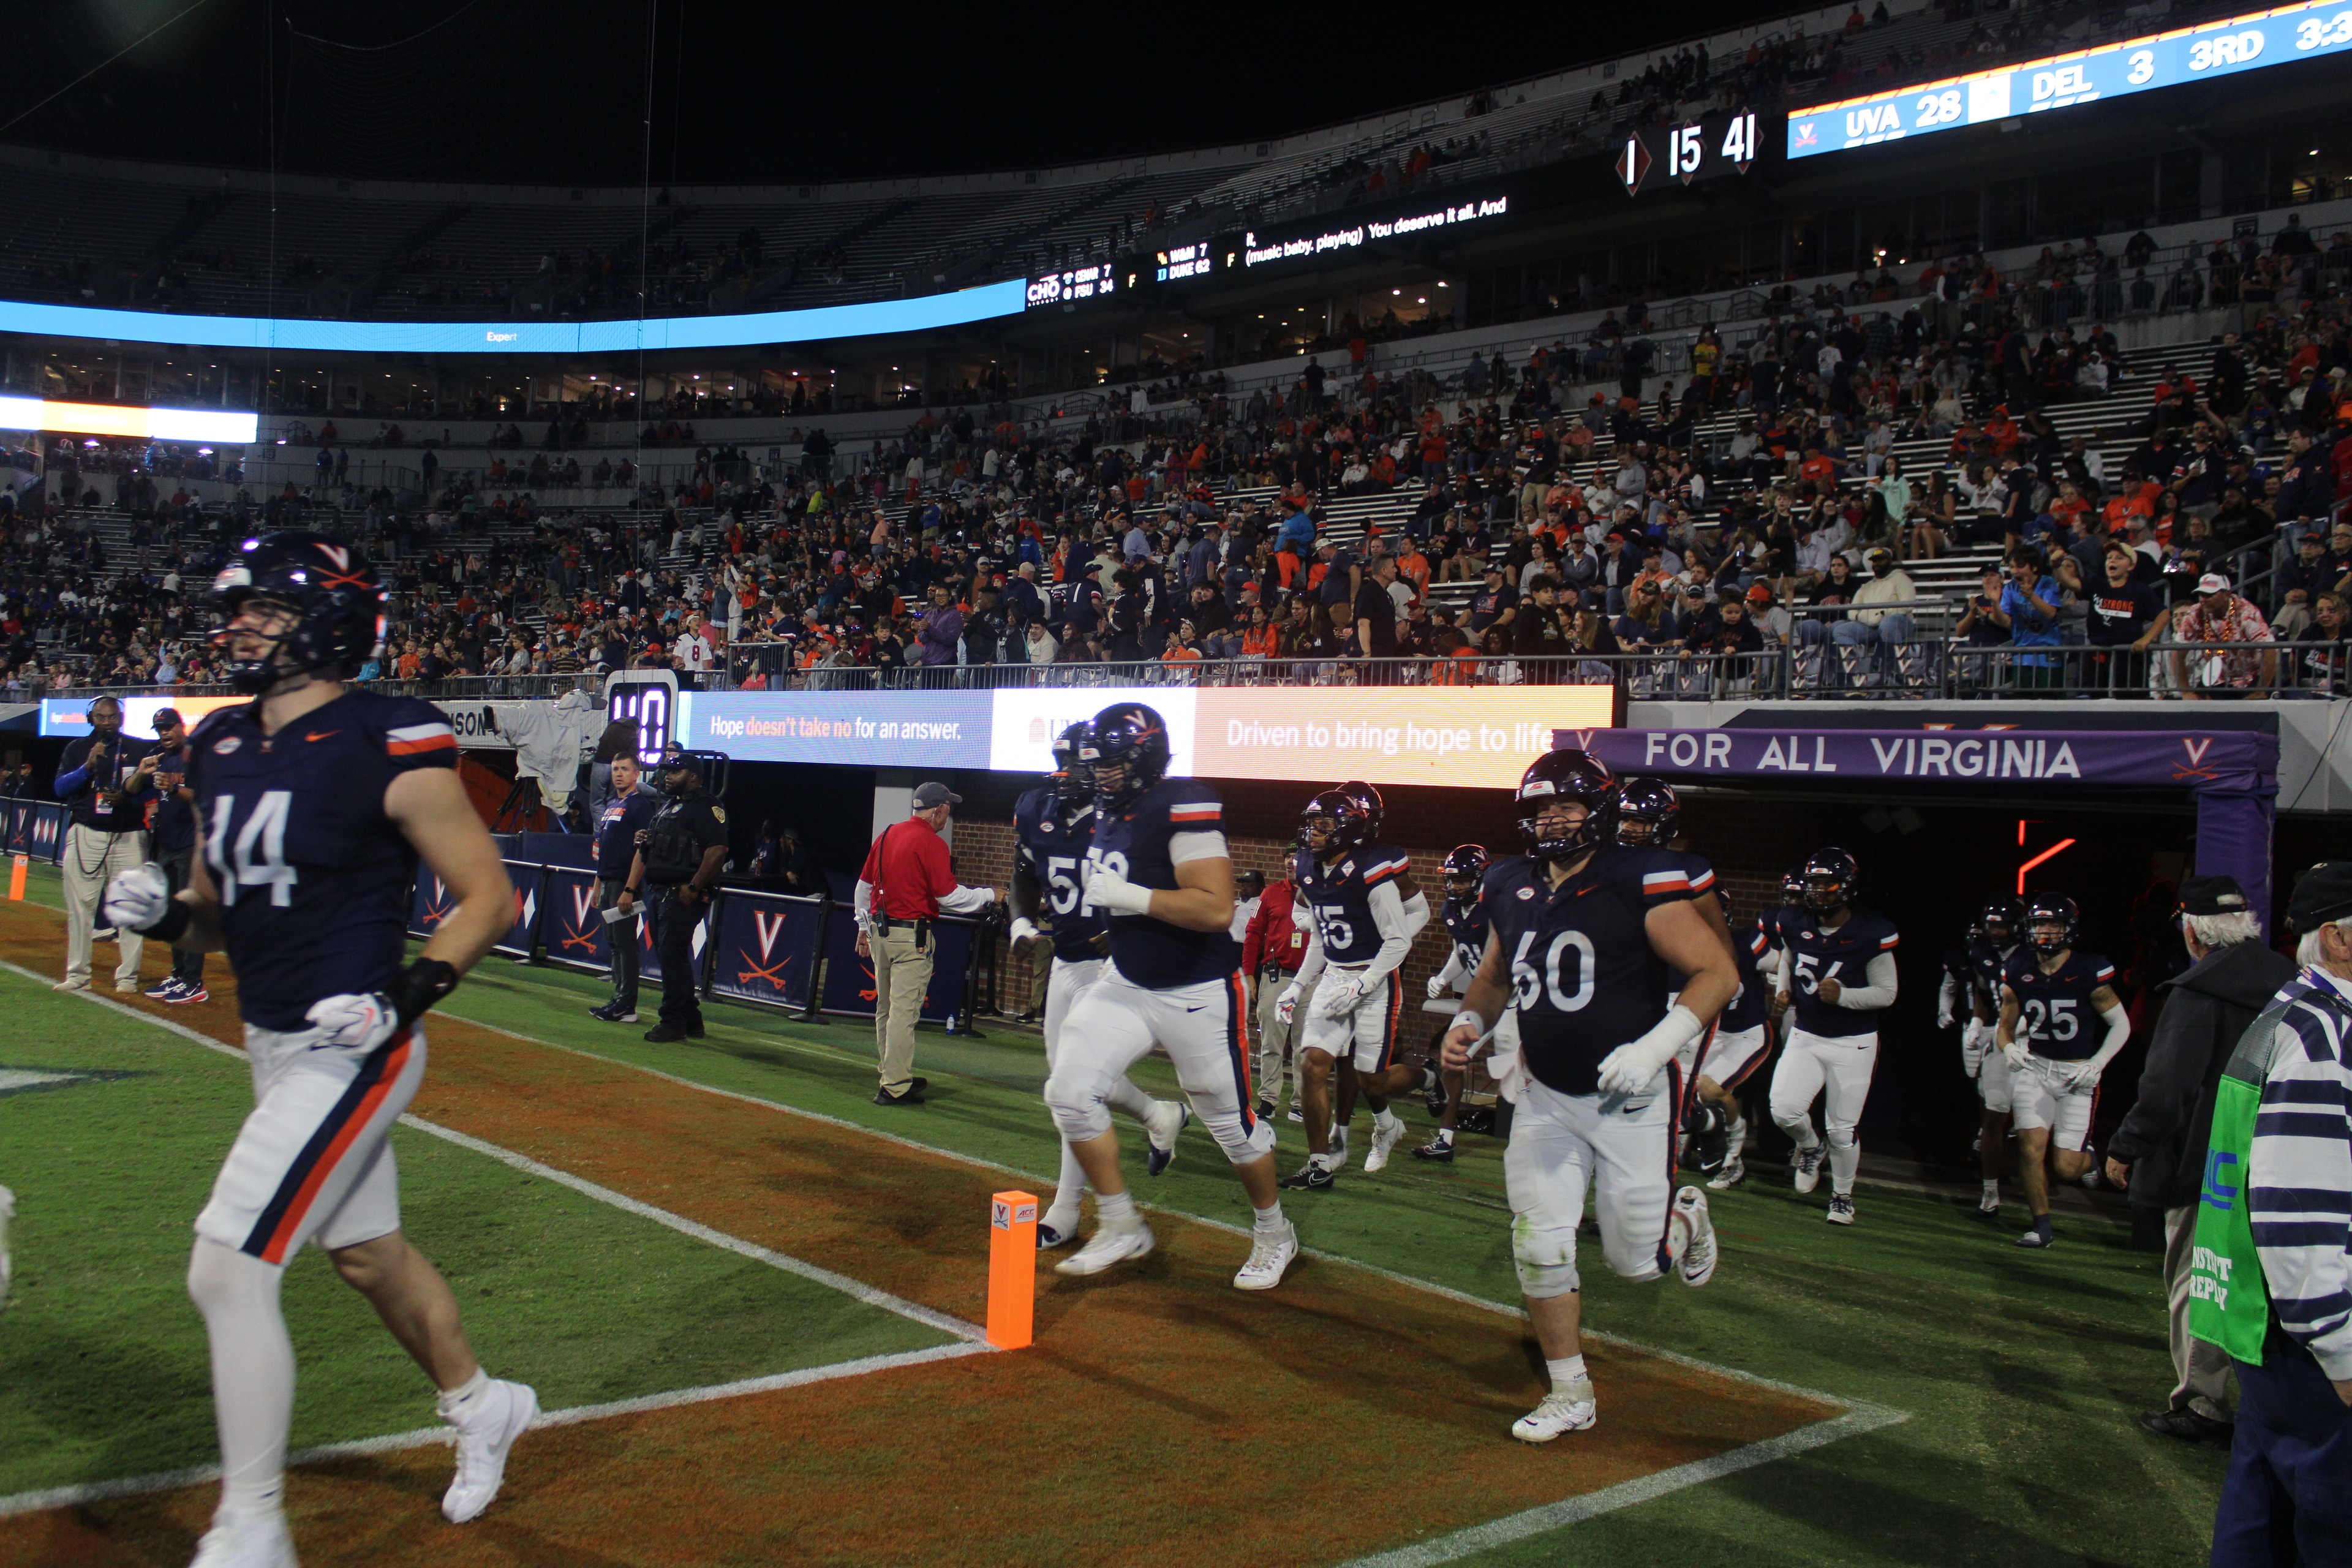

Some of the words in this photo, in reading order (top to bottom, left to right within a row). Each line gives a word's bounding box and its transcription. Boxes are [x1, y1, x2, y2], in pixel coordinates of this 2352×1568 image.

[2033, 65, 2093, 102] DEL
[2127, 50, 2154, 85] 3
[2188, 30, 2264, 71] 3RD
[1846, 104, 1901, 138] UVA
[1917, 90, 1962, 129] 28
[1670, 126, 1702, 176] 15
[1721, 114, 1755, 162] 41
[1627, 140, 1635, 184] 1
[1199, 243, 1208, 257] 7
[1246, 244, 1283, 267] (music
[1284, 238, 1314, 257] baby.
[1316, 226, 1363, 253] playing)
[1368, 223, 1392, 239] You
[1394, 210, 1444, 234] deserve
[1447, 208, 1456, 224] it
[1457, 203, 1477, 221] all.
[1479, 197, 1507, 217] And
[1103, 263, 1112, 278] 7
[1169, 262, 1195, 280] DUKE
[1195, 258, 1210, 274] 62
[1227, 252, 1235, 268] F
[1027, 280, 1060, 301] CHO
[1074, 282, 1094, 299] FSU
[1099, 278, 1114, 294] 34
[1128, 274, 1136, 288] F
[486, 331, 518, 342] Expert
[692, 644, 700, 662] 8
[710, 715, 744, 739] Hope
[745, 716, 796, 737] doesn't
[799, 716, 831, 737] take
[832, 722, 852, 737] no
[855, 715, 878, 739] for
[879, 721, 902, 739] an
[902, 721, 962, 741] answer.
[1226, 719, 1298, 747] Driven
[1305, 723, 1330, 747] to
[1335, 721, 1399, 755] bring
[1407, 722, 1470, 755] hope
[1479, 723, 1507, 752] to
[1515, 723, 1553, 753] life
[1646, 732, 1732, 769] FOR
[1757, 736, 1837, 772] ALL
[1871, 737, 2082, 778] VIRGINIA
[207, 790, 298, 907] 14
[1313, 905, 1353, 949] 15
[1511, 930, 1596, 1012] 60
[2025, 998, 2079, 1041] 25
[1017, 1208, 1035, 1217] ACC
